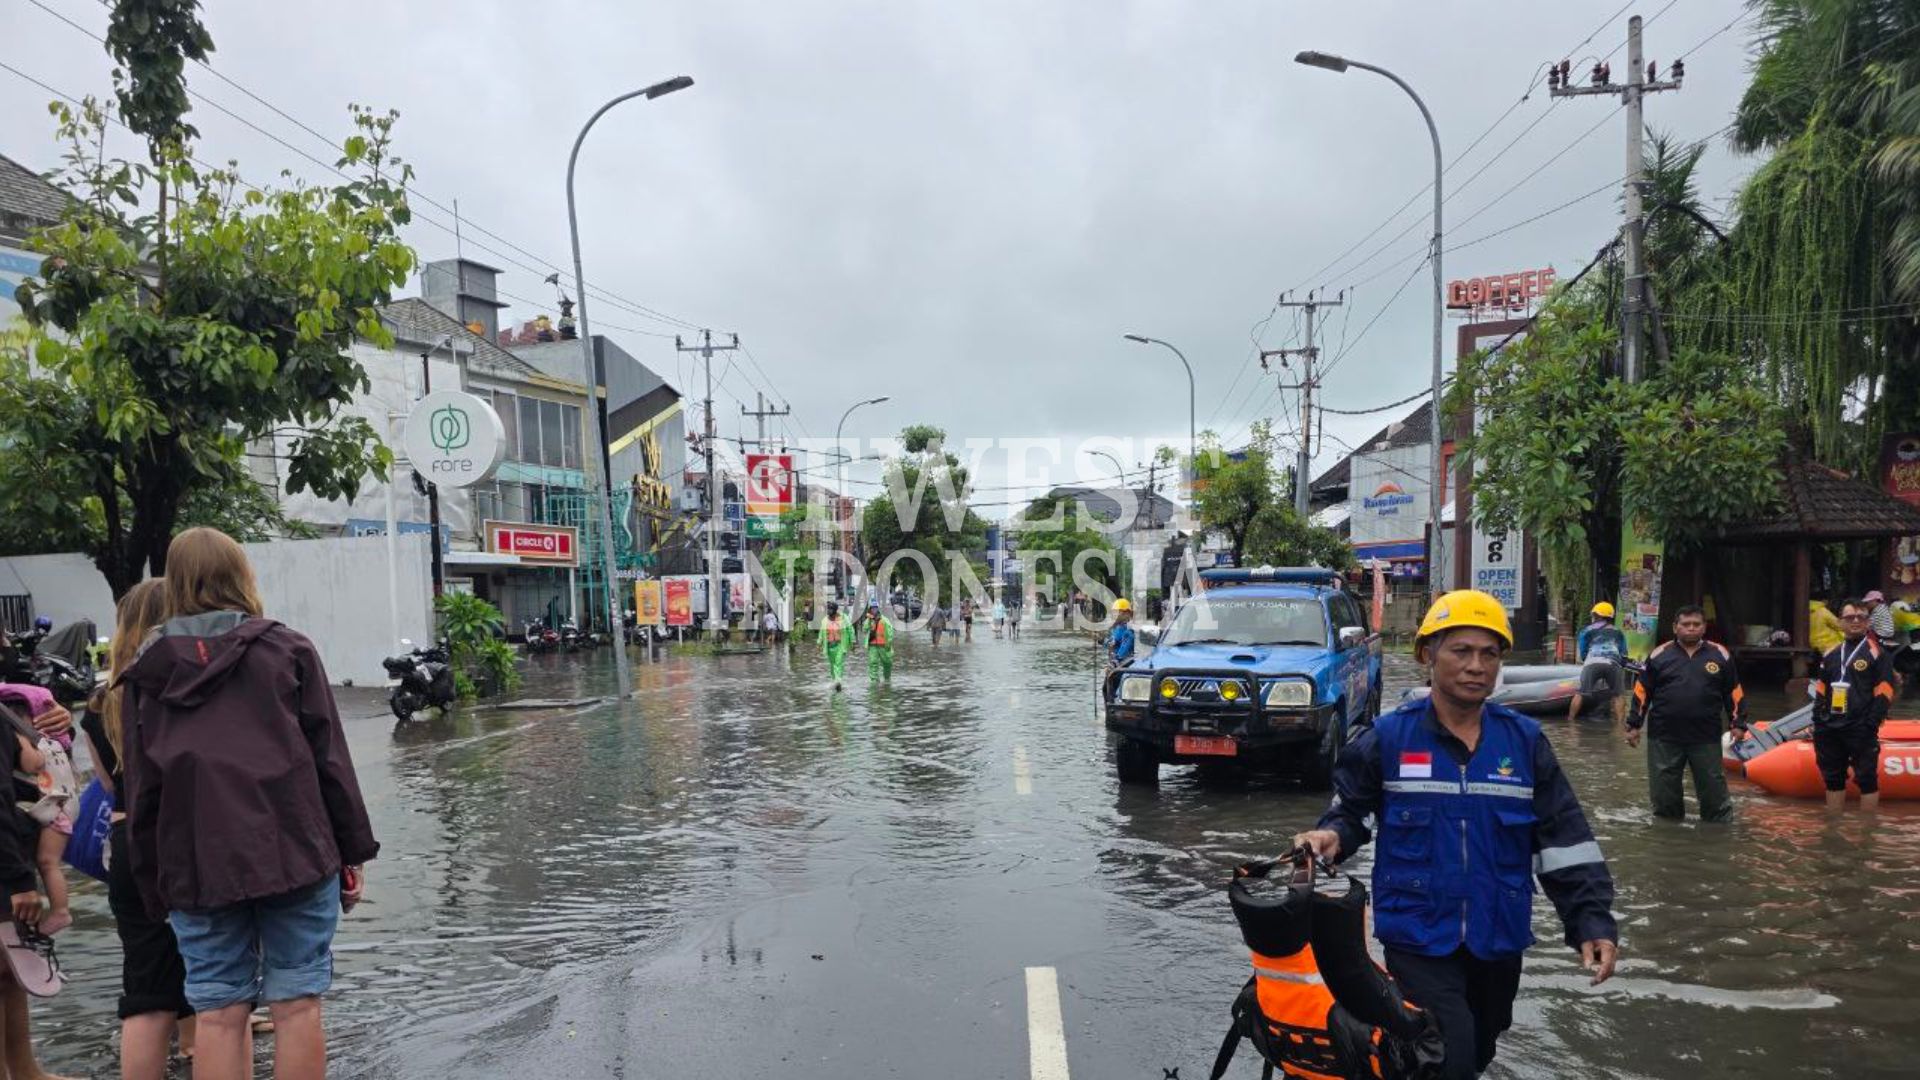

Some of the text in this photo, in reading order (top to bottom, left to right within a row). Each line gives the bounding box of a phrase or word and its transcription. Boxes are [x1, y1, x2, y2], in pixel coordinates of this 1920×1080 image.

[1447, 267, 1556, 306] COFFEE
[516, 537, 543, 547] CIRCLE
[1478, 569, 1517, 580] OPEN
